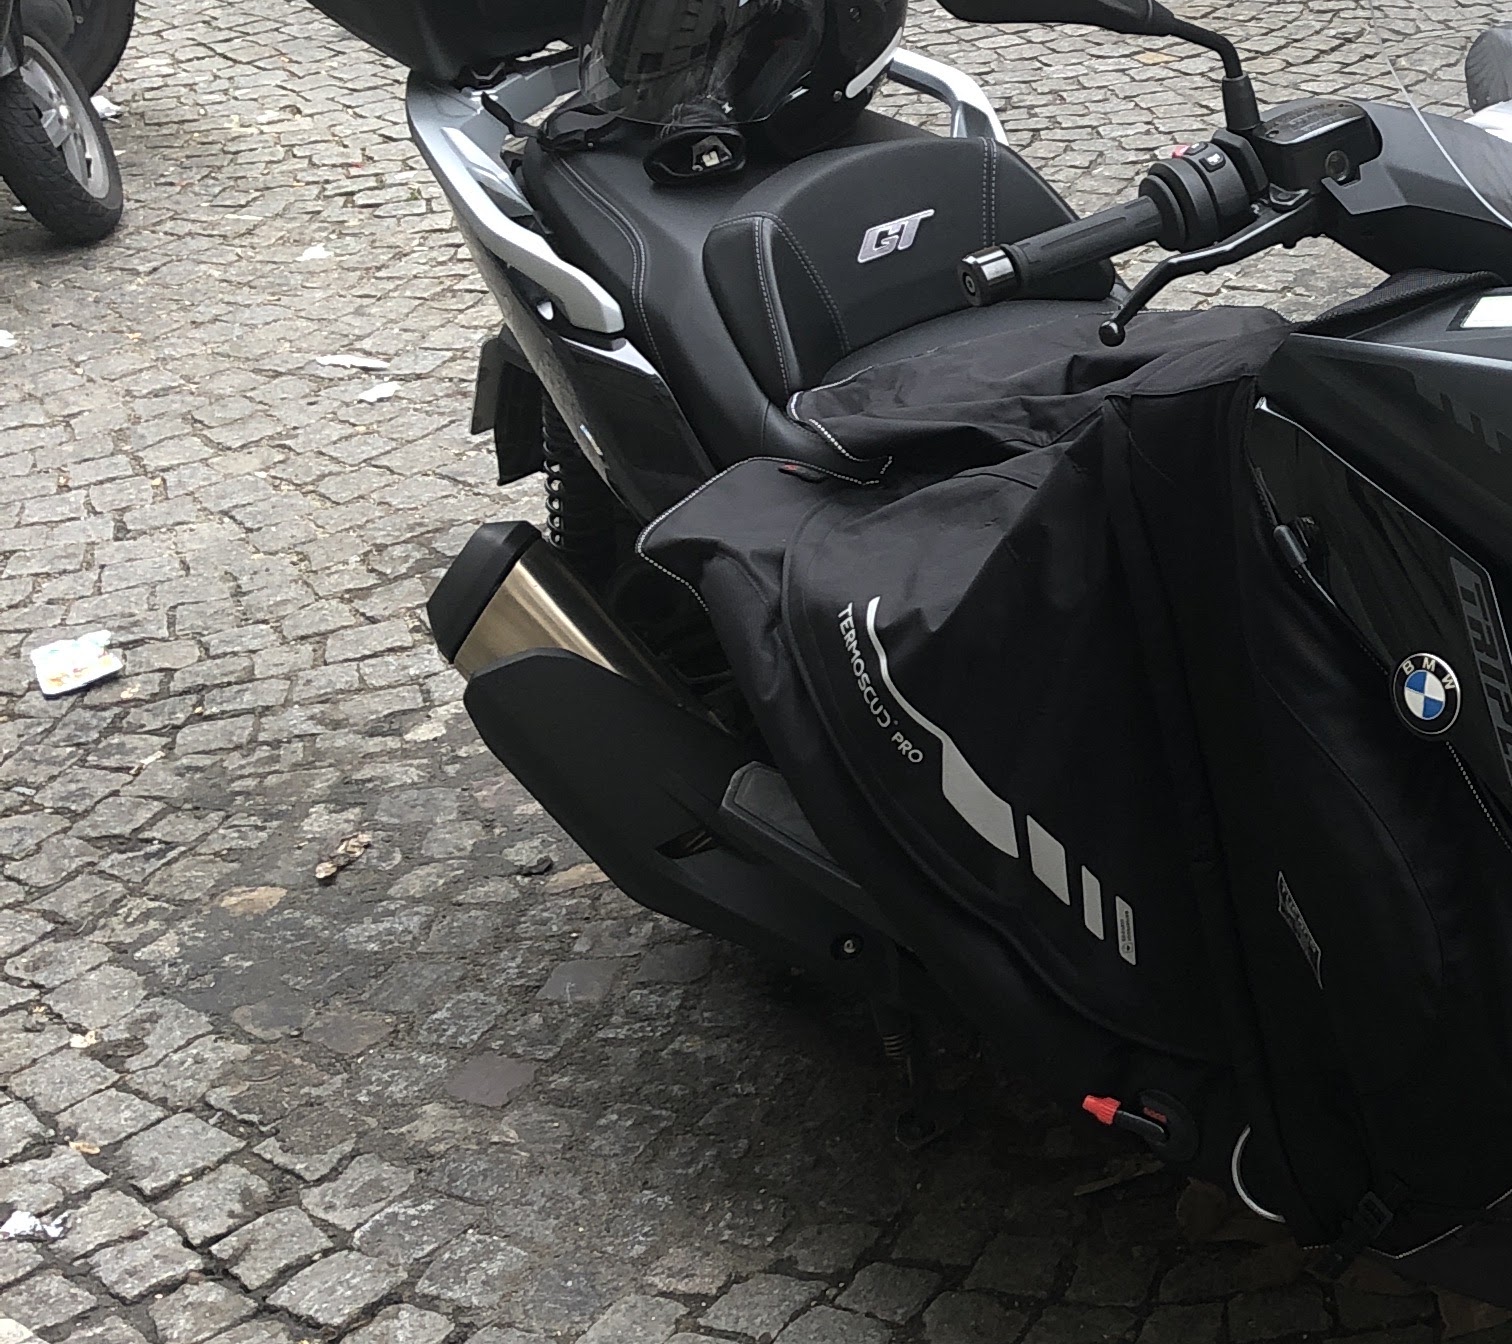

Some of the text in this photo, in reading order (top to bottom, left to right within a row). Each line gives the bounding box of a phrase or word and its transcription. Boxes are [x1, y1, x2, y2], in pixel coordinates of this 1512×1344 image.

[857, 208, 935, 263] GT
[1402, 657, 1456, 690] BMW
[891, 732, 924, 764] PRO
